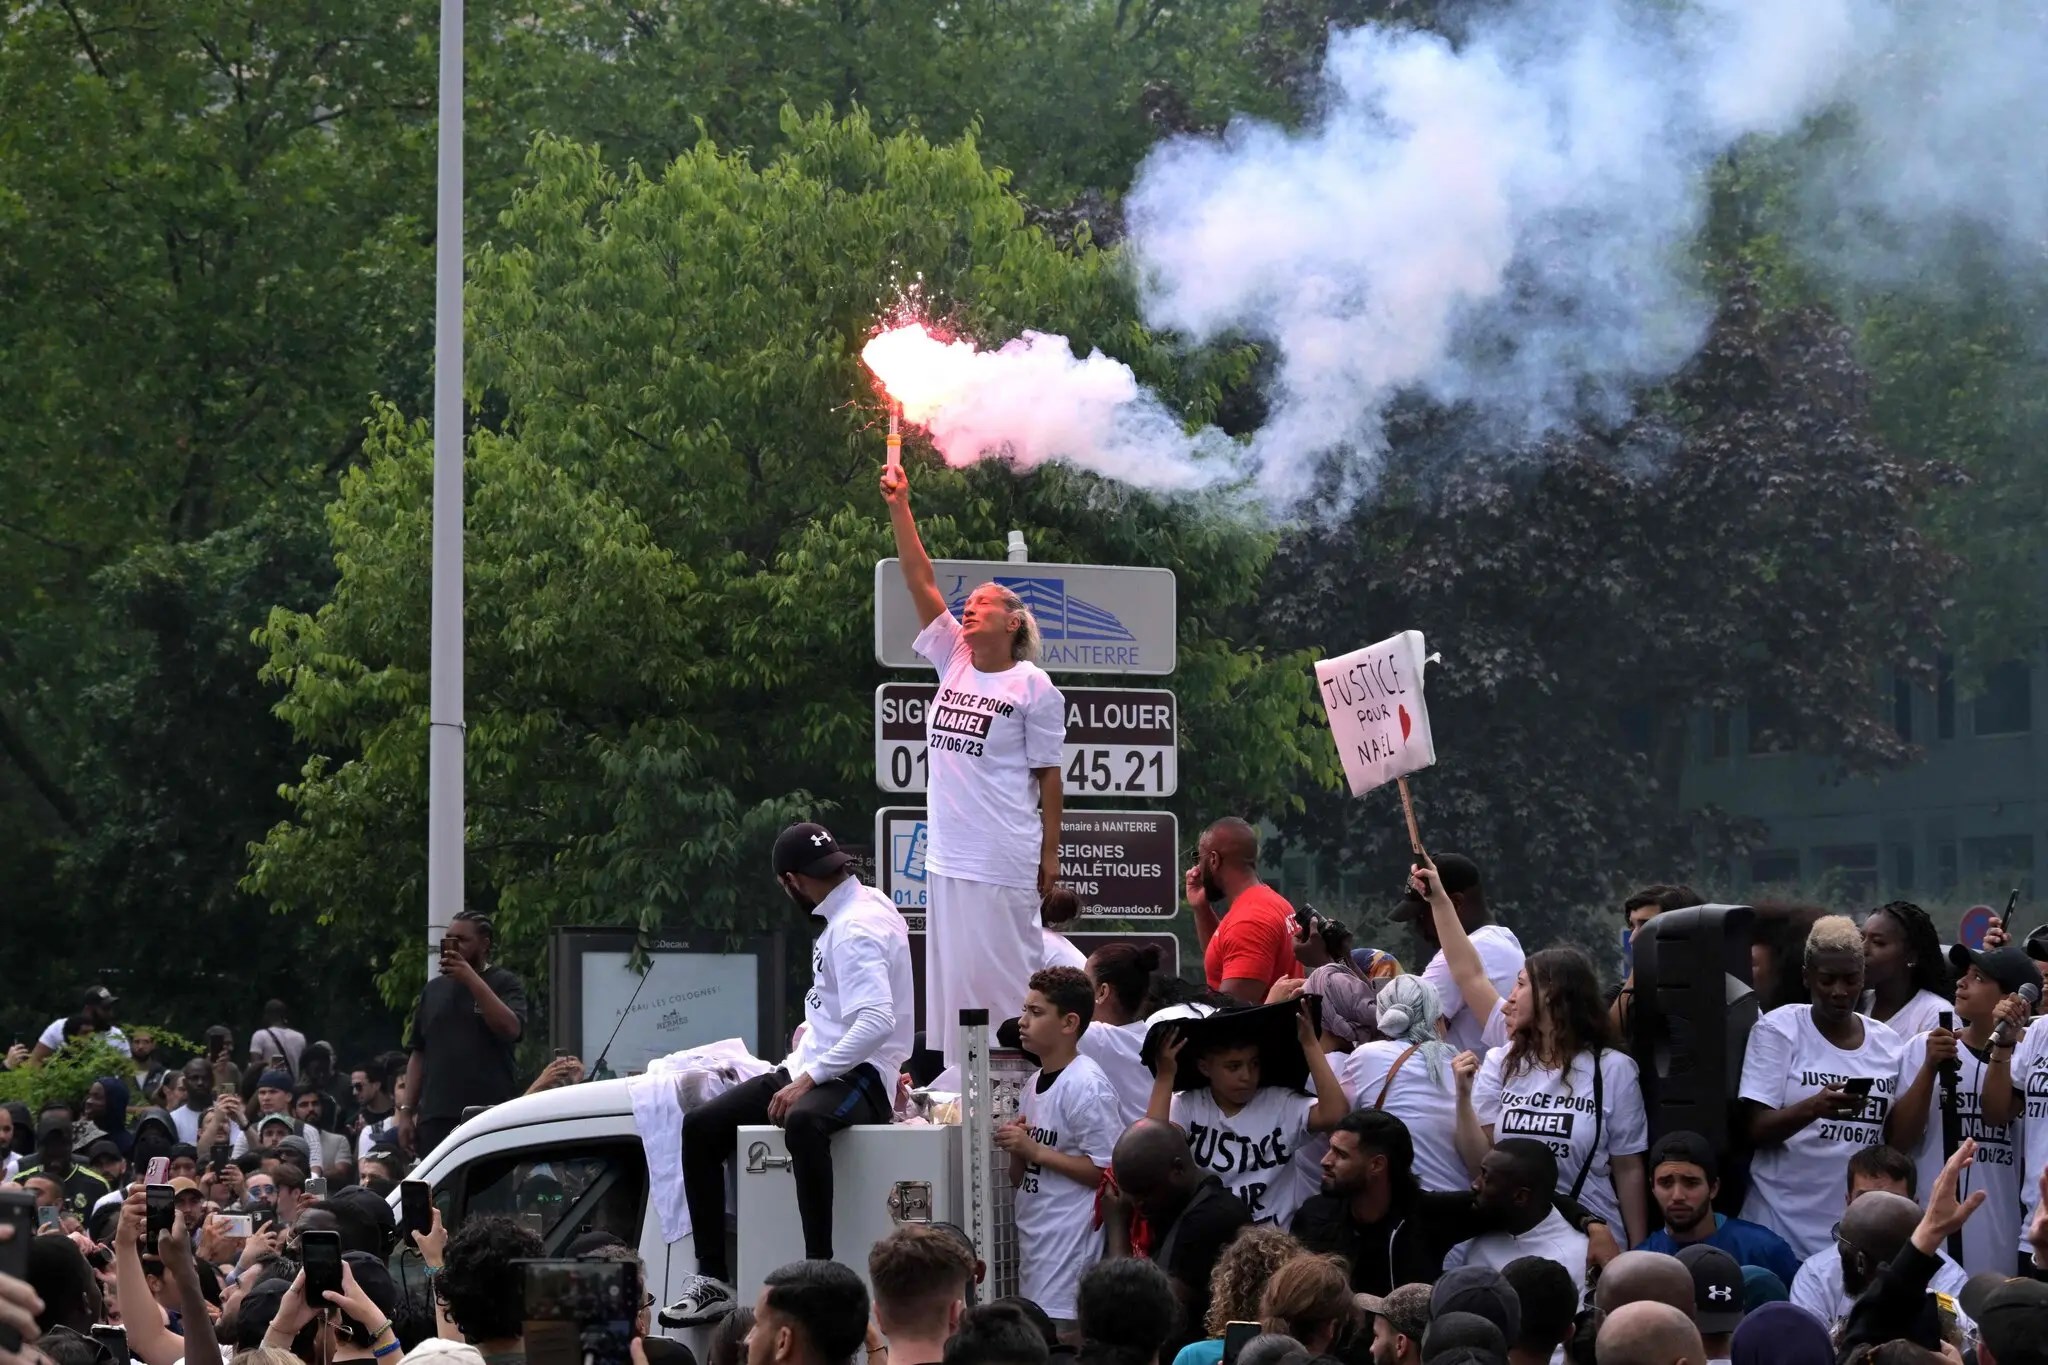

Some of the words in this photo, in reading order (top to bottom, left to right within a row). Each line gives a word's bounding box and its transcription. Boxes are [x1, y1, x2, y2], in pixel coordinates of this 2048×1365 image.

[977, 696, 1014, 718] POUR
[1066, 703, 1084, 728] A
[1090, 703, 1172, 730] LOUER
[1357, 704, 1391, 731] POUR
[935, 709, 985, 735] NAHEL
[930, 733, 984, 758] 27/06/23
[1102, 821, 1158, 833] NANTERRE
[1553, 1095, 1595, 1115] POUR
[1504, 1111, 1568, 1135] NAHEL
